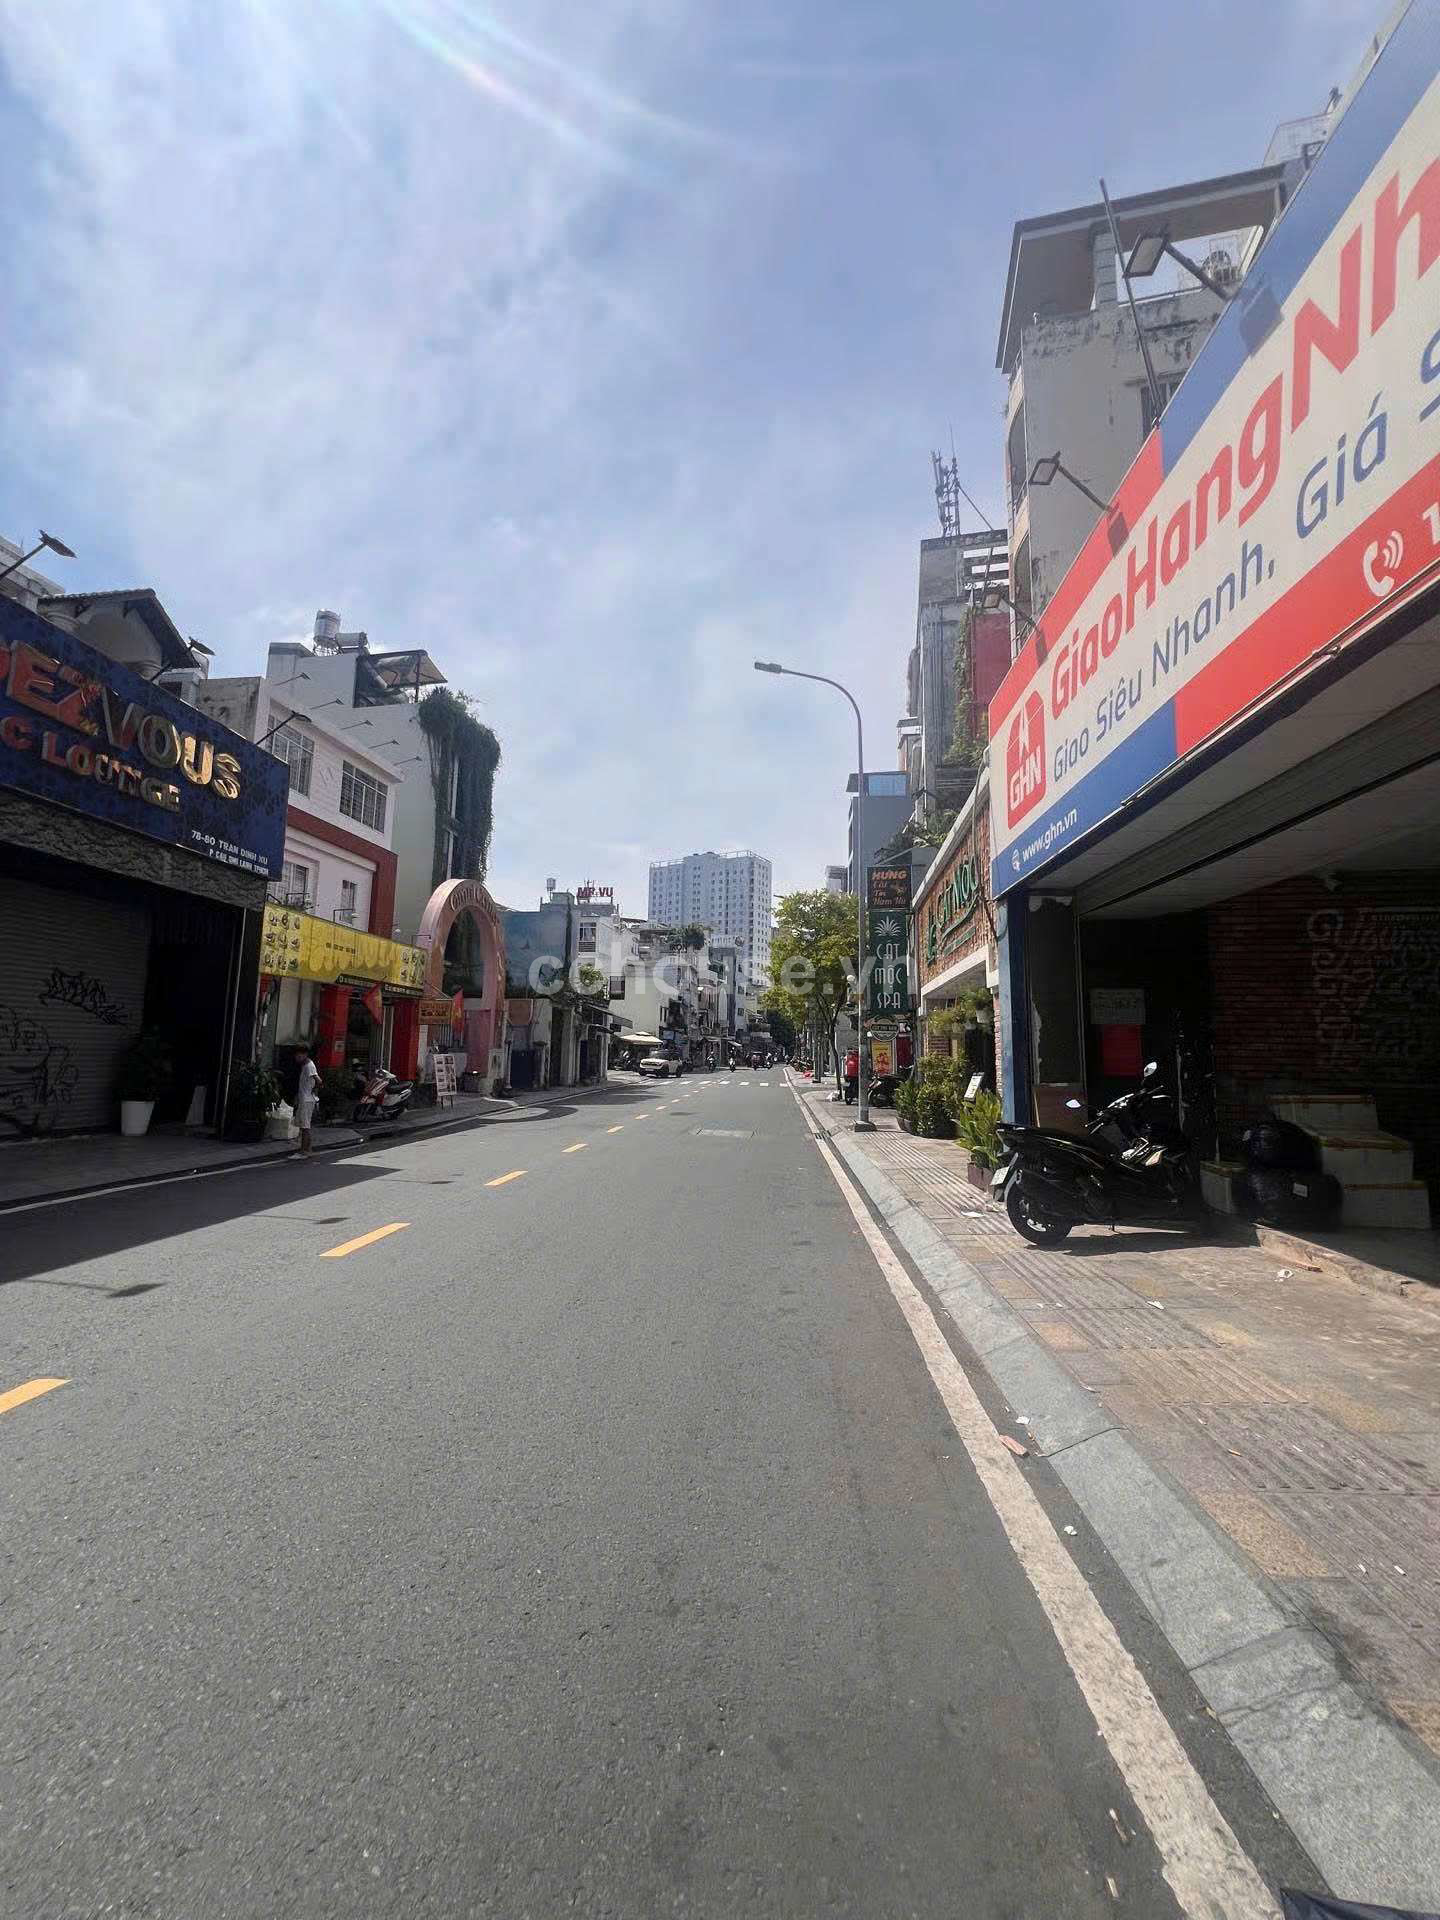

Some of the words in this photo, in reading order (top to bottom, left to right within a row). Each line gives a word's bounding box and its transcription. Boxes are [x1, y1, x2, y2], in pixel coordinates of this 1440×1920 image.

[1053, 727, 1090, 783] Giao
[1096, 668, 1143, 743] Siêu
[1153, 539, 1276, 688] Nhanh,
[1296, 390, 1388, 540] Giá
[41, 730, 182, 813] LOUNGE
[1009, 744, 1042, 812] GHN
[1022, 807, 1078, 863] www.ghn.vn
[876, 991, 902, 1009] SPA
